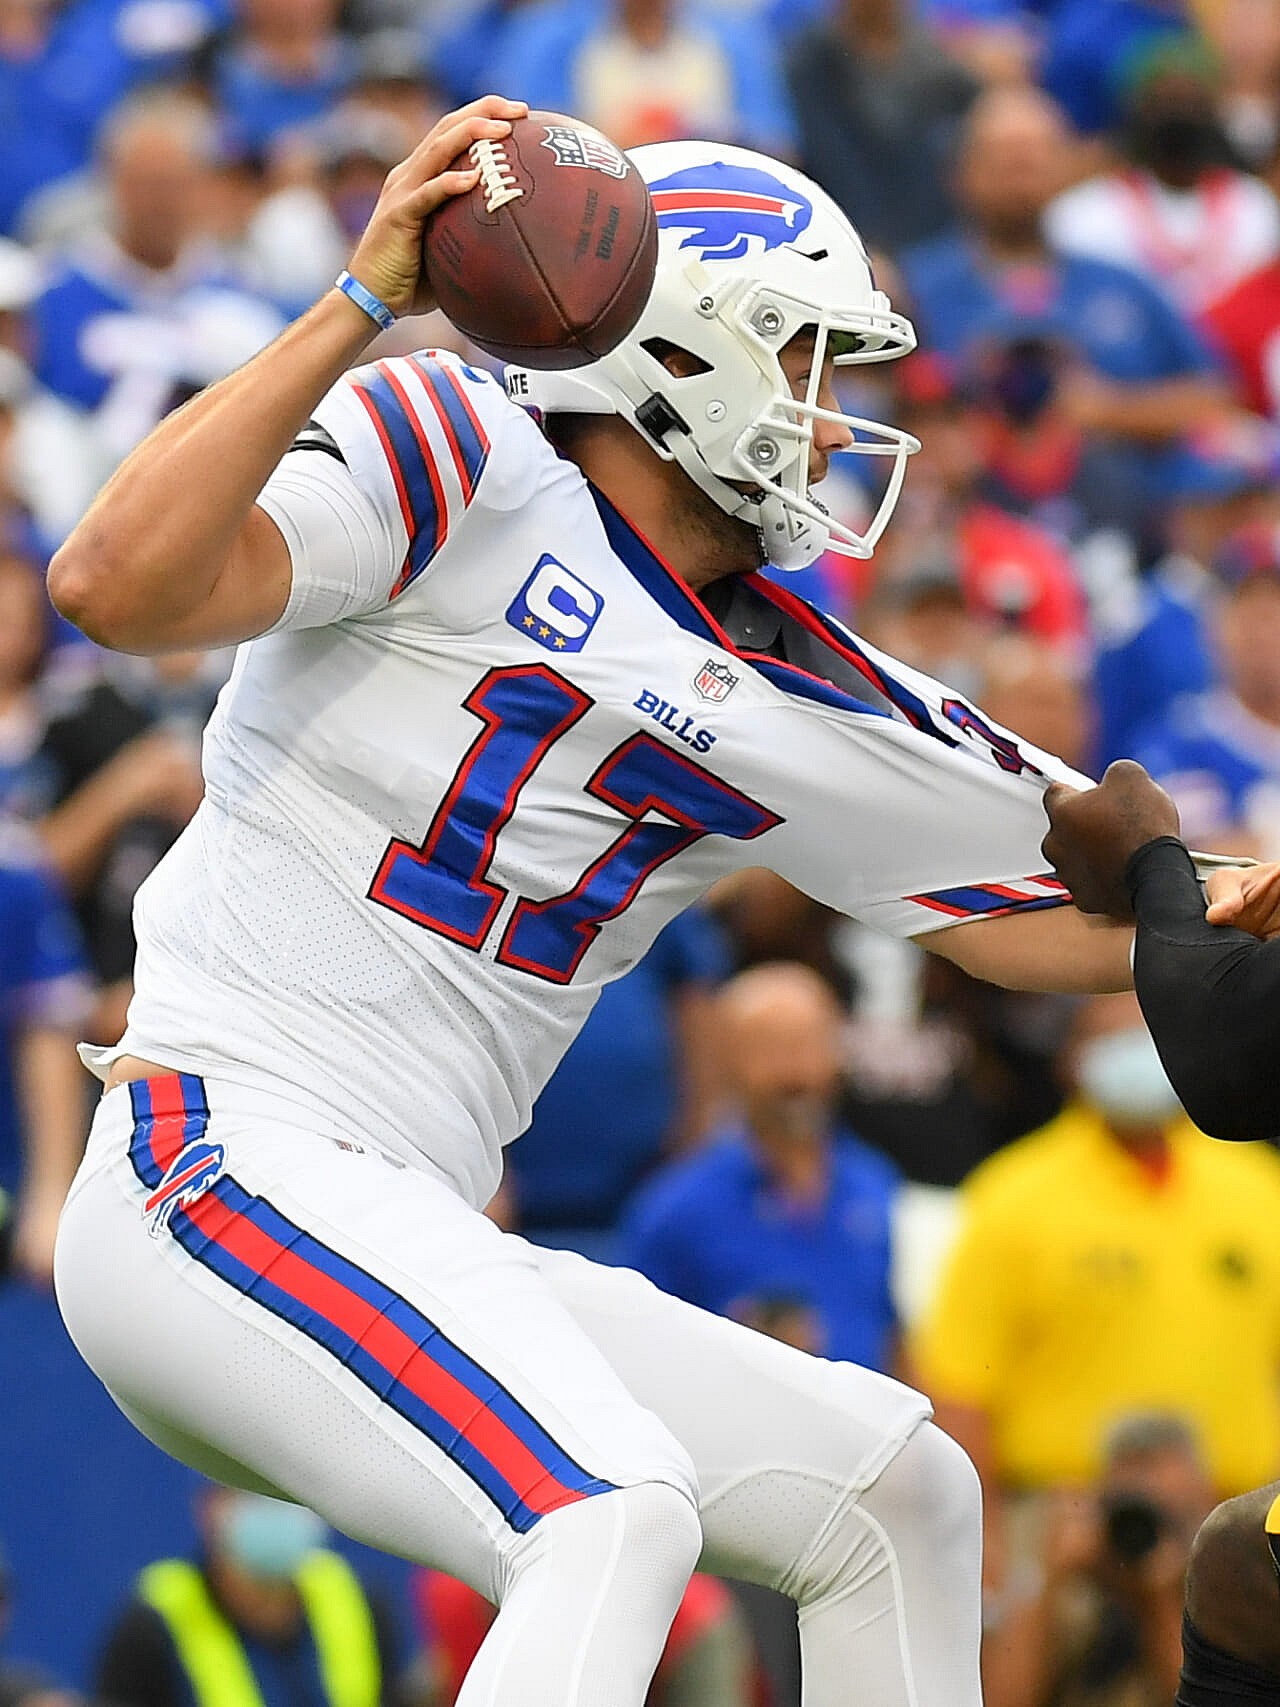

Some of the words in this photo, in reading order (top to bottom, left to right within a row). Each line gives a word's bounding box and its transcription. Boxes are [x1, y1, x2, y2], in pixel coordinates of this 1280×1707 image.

[526, 563, 597, 638] C
[697, 671, 725, 699] NFL
[633, 688, 718, 753] BILLS
[367, 662, 787, 985] 17
